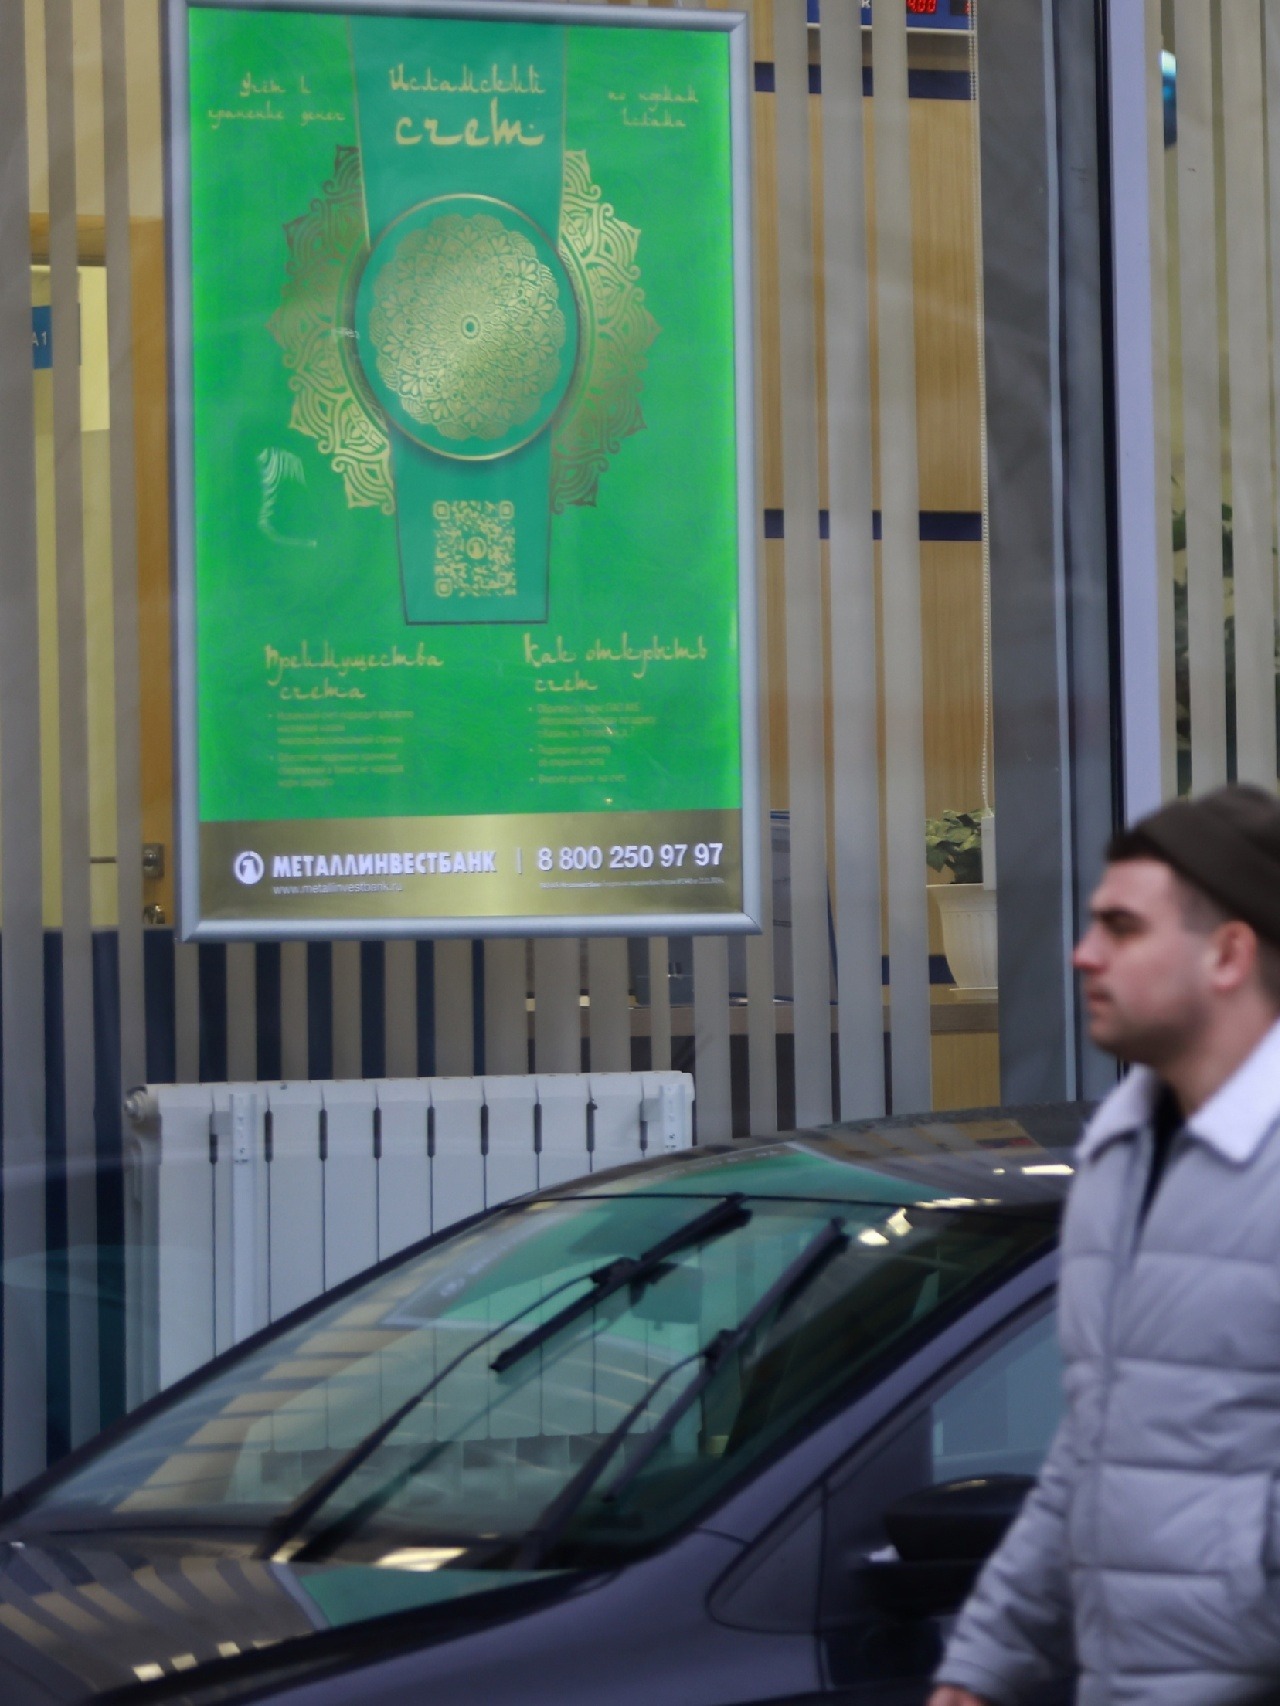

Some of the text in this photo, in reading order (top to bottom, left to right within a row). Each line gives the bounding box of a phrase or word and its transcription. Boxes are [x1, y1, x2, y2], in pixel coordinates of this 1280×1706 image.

[388, 62, 546, 94] Исламский
[396, 96, 545, 146] счет
[264, 639, 445, 687] Преимущества
[524, 631, 708, 679] Как открыть
[272, 842, 723, 878] МЕТАЛЛИНВЕСТБАНК 8 800 250 97 97
